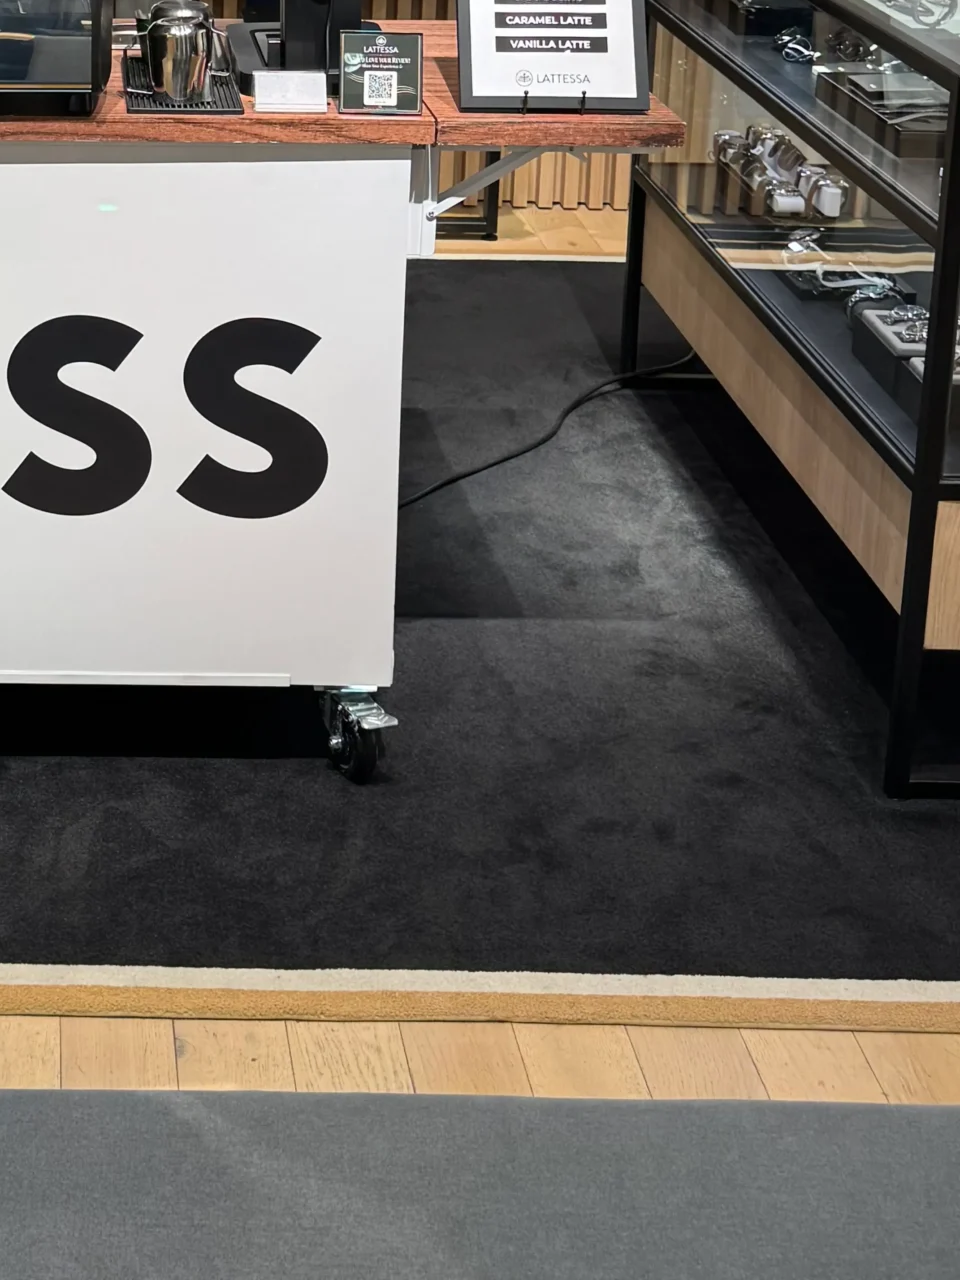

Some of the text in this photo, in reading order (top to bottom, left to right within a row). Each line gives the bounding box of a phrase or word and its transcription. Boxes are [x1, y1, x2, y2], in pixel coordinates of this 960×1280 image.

[505, 15, 593, 25] CARAMEL LATTE
[509, 39, 591, 49] VANILLA LATTE
[536, 74, 591, 84] LATTESSA
